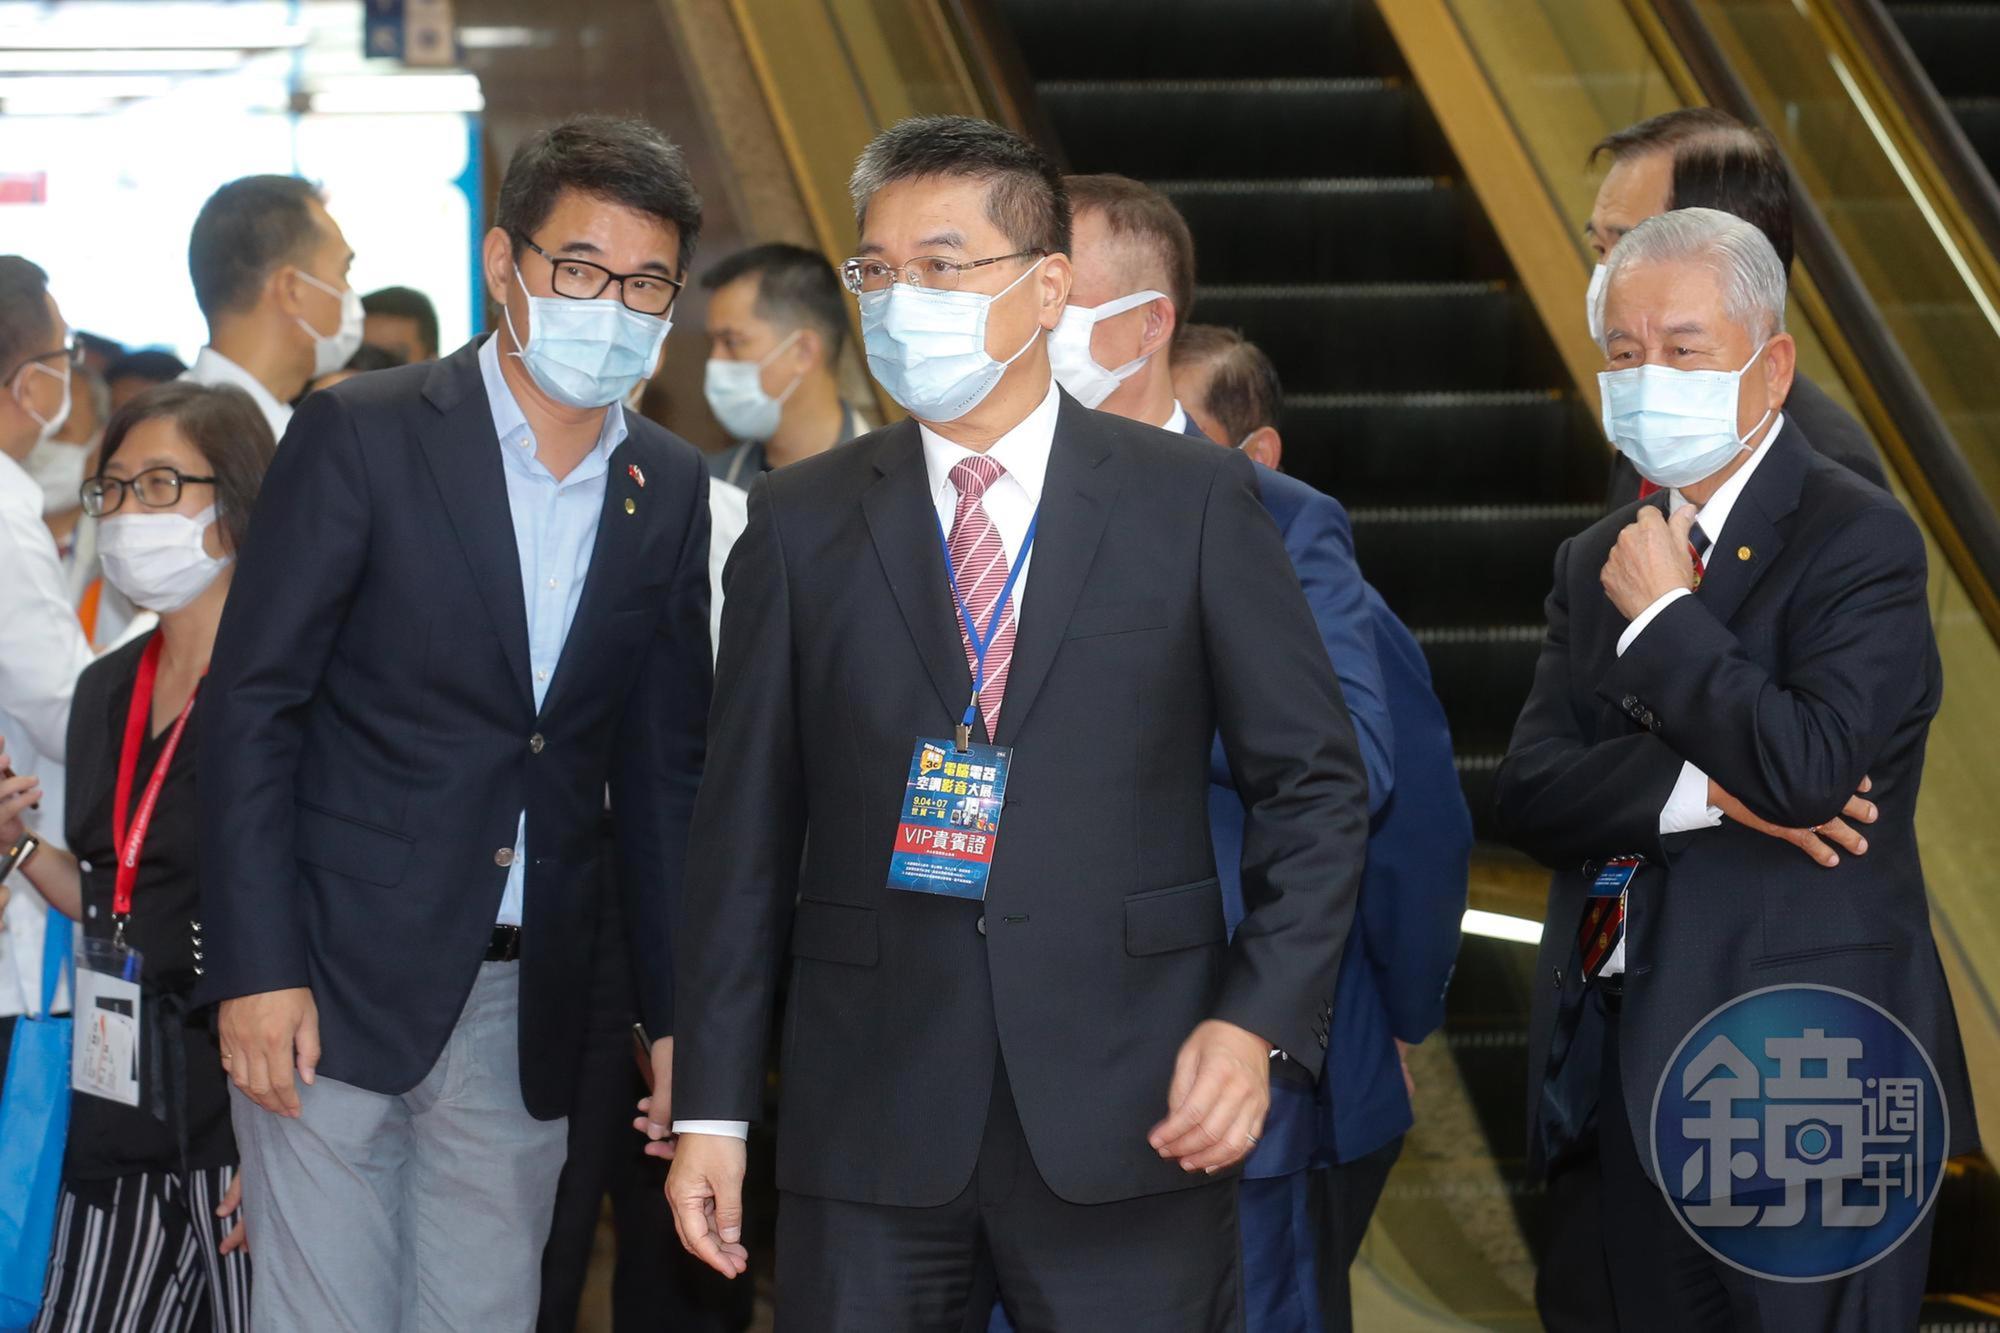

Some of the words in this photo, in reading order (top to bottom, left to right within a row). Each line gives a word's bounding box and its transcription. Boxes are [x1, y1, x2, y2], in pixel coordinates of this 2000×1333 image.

[944, 761, 996, 781] 電腦電器
[915, 776, 994, 798] 空調影音大展
[904, 827, 987, 855] VIP貴賓證
